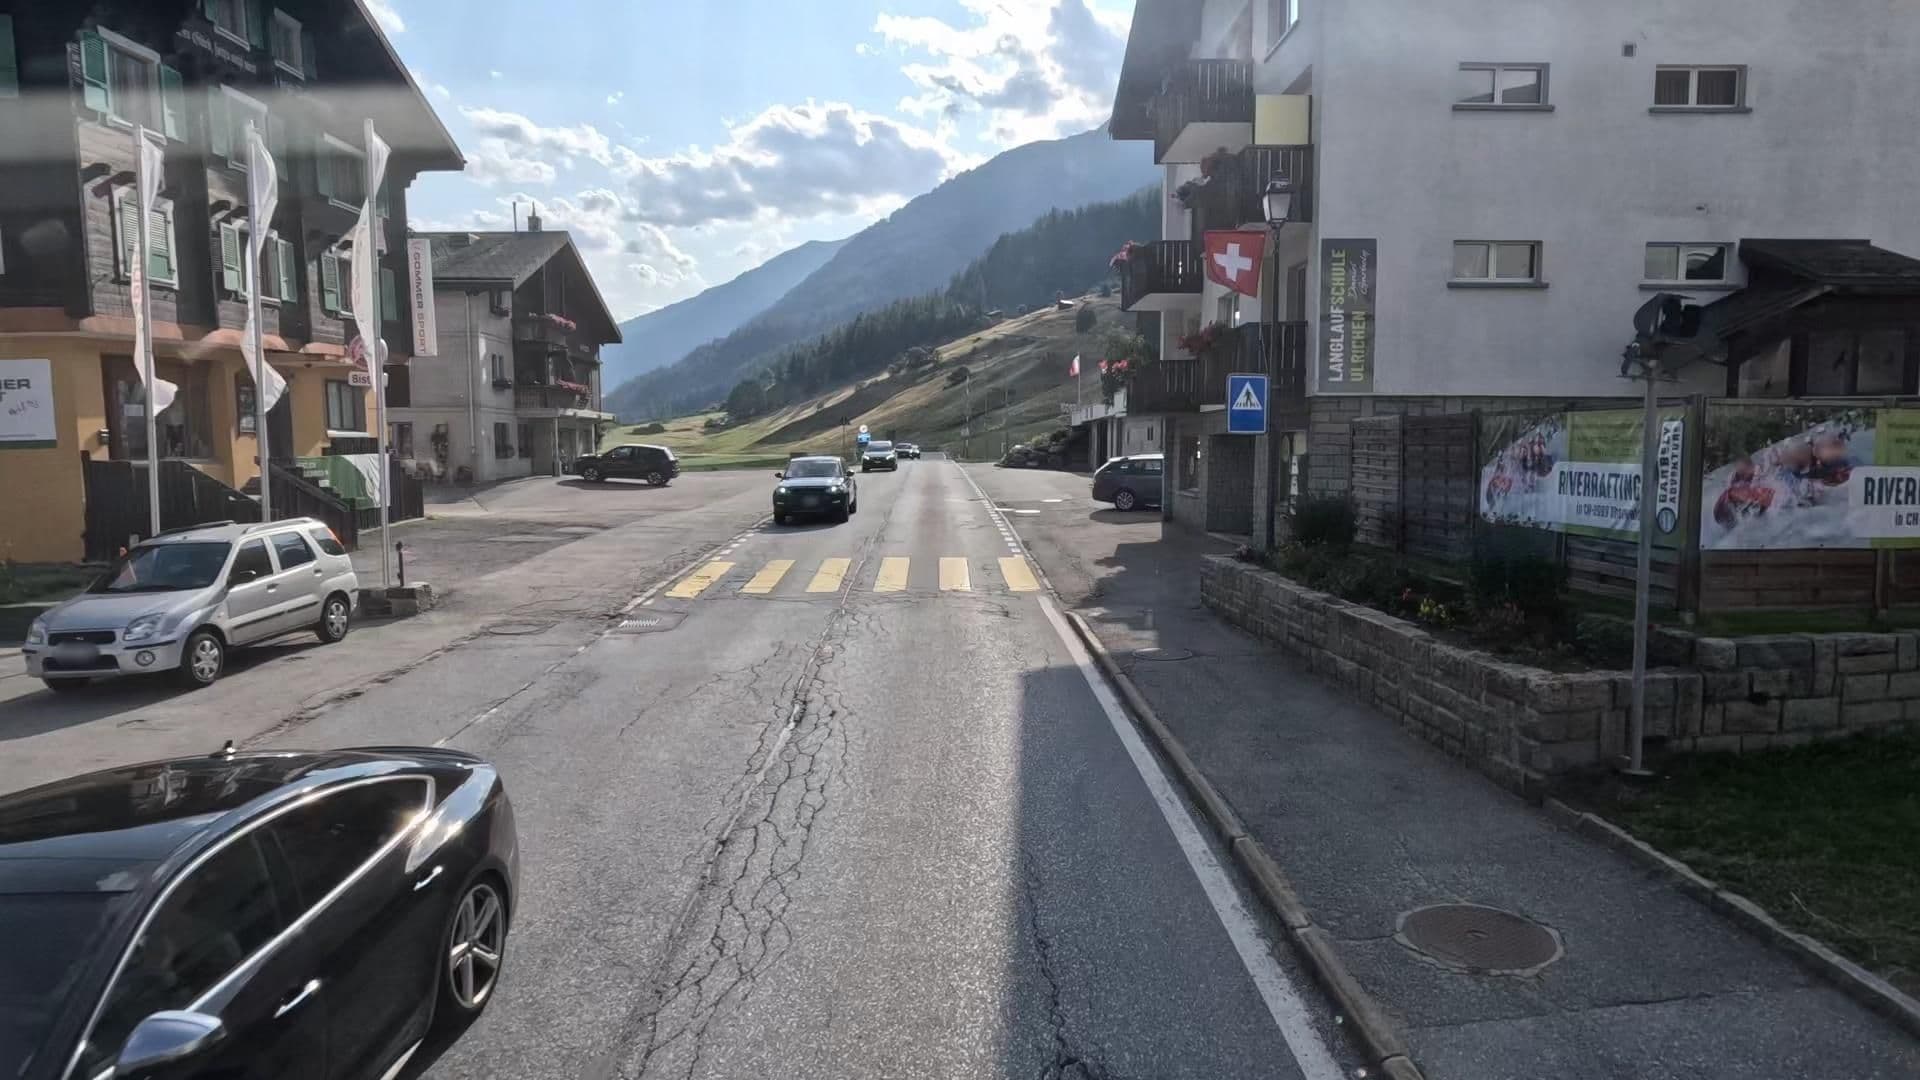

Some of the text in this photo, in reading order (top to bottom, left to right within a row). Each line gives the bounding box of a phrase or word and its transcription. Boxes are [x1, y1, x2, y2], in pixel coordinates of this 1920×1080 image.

[413, 252, 426, 353] GOMMER SPORT
[1328, 249, 1346, 382] LANGLAUFSCHULE
[1350, 311, 1366, 382] ULRICHEN
[351, 375, 371, 385] Bist
[1558, 470, 1641, 501] RIVERRAFTING
[1863, 477, 1920, 505] RIVER
